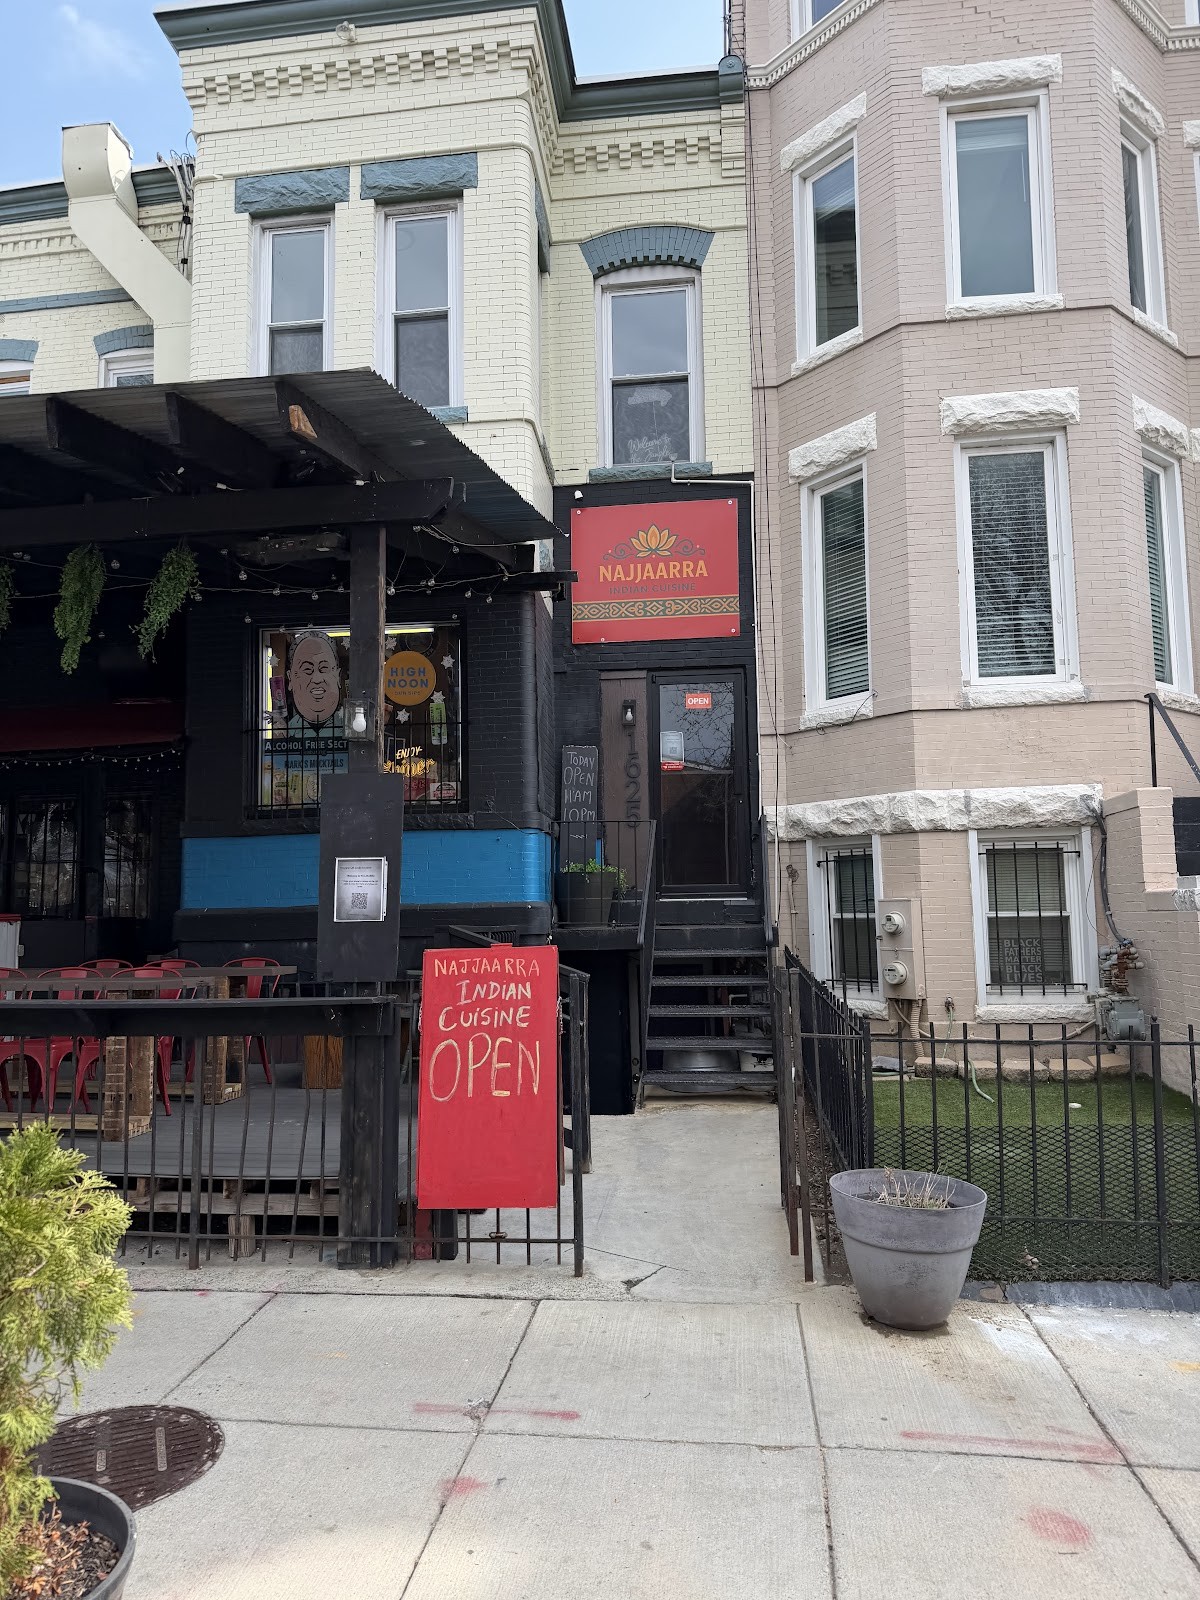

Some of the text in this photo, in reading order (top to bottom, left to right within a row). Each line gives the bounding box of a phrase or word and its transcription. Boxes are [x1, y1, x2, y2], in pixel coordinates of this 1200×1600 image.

[599, 560, 708, 583] NAJJAARRA
[609, 582, 696, 595] INDIAN CUISINE
[390, 666, 426, 677] HIGH
[387, 678, 429, 688] NOON
[687, 697, 709, 705] OPEN
[305, 740, 325, 749] FREE
[563, 766, 595, 787] OPEN
[624, 730, 642, 828] 1625
[1004, 939, 1041, 947] BLACK
[1004, 947, 1042, 956] FATHERS
[1005, 965, 1043, 973] BLACK
[1006, 973, 1043, 983] LIVES
[429, 1032, 540, 1102] OPEN
